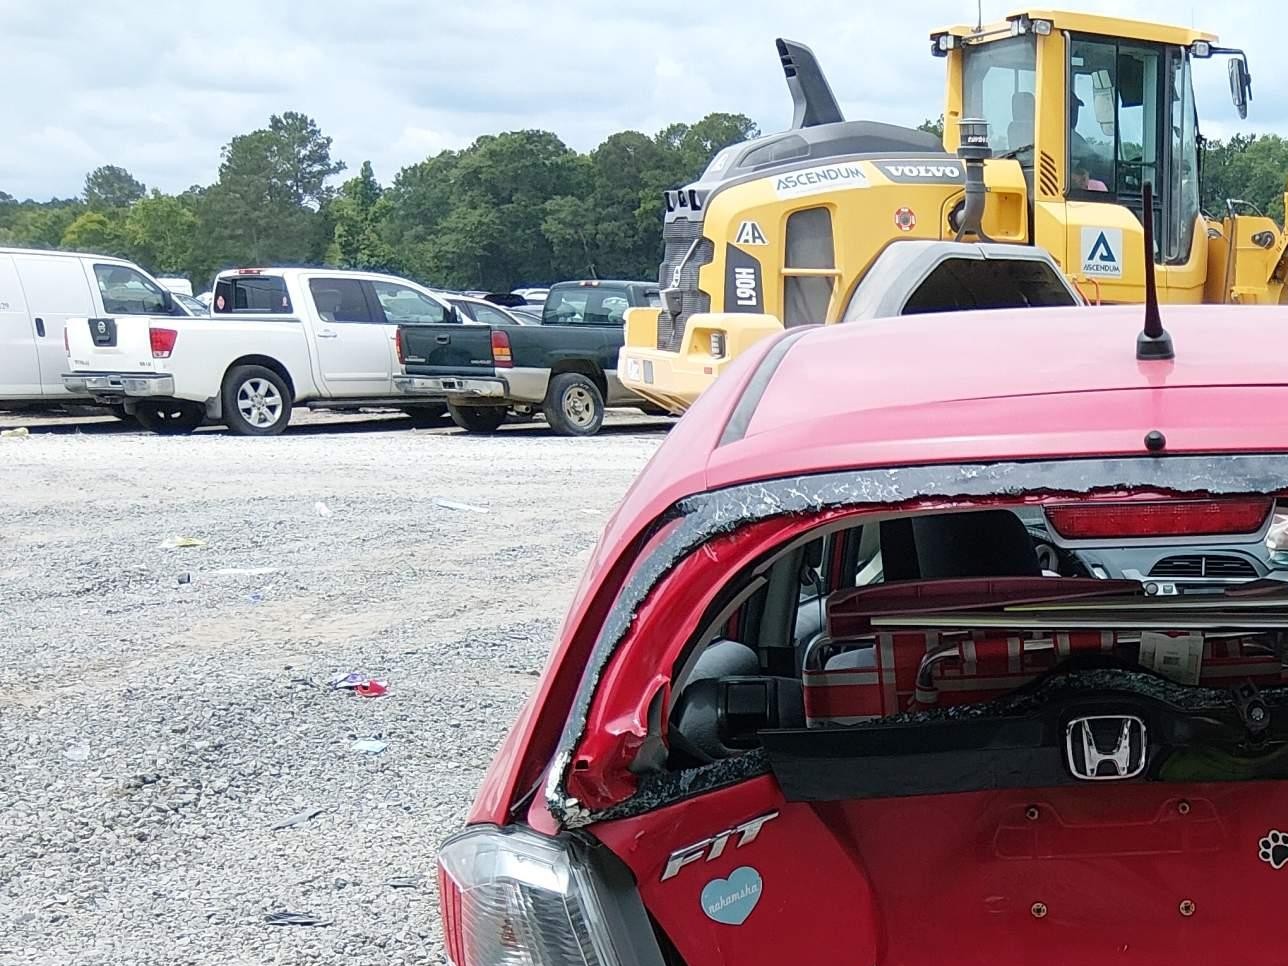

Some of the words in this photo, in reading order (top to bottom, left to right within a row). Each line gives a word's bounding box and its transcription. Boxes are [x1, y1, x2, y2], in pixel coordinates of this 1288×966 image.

[776, 167, 866, 191] ASCENDUM
[885, 166, 960, 178] VOLVO
[1084, 264, 1120, 273] ASCENDUM
[735, 268, 757, 306] L90H
[660, 811, 779, 882] FIT
